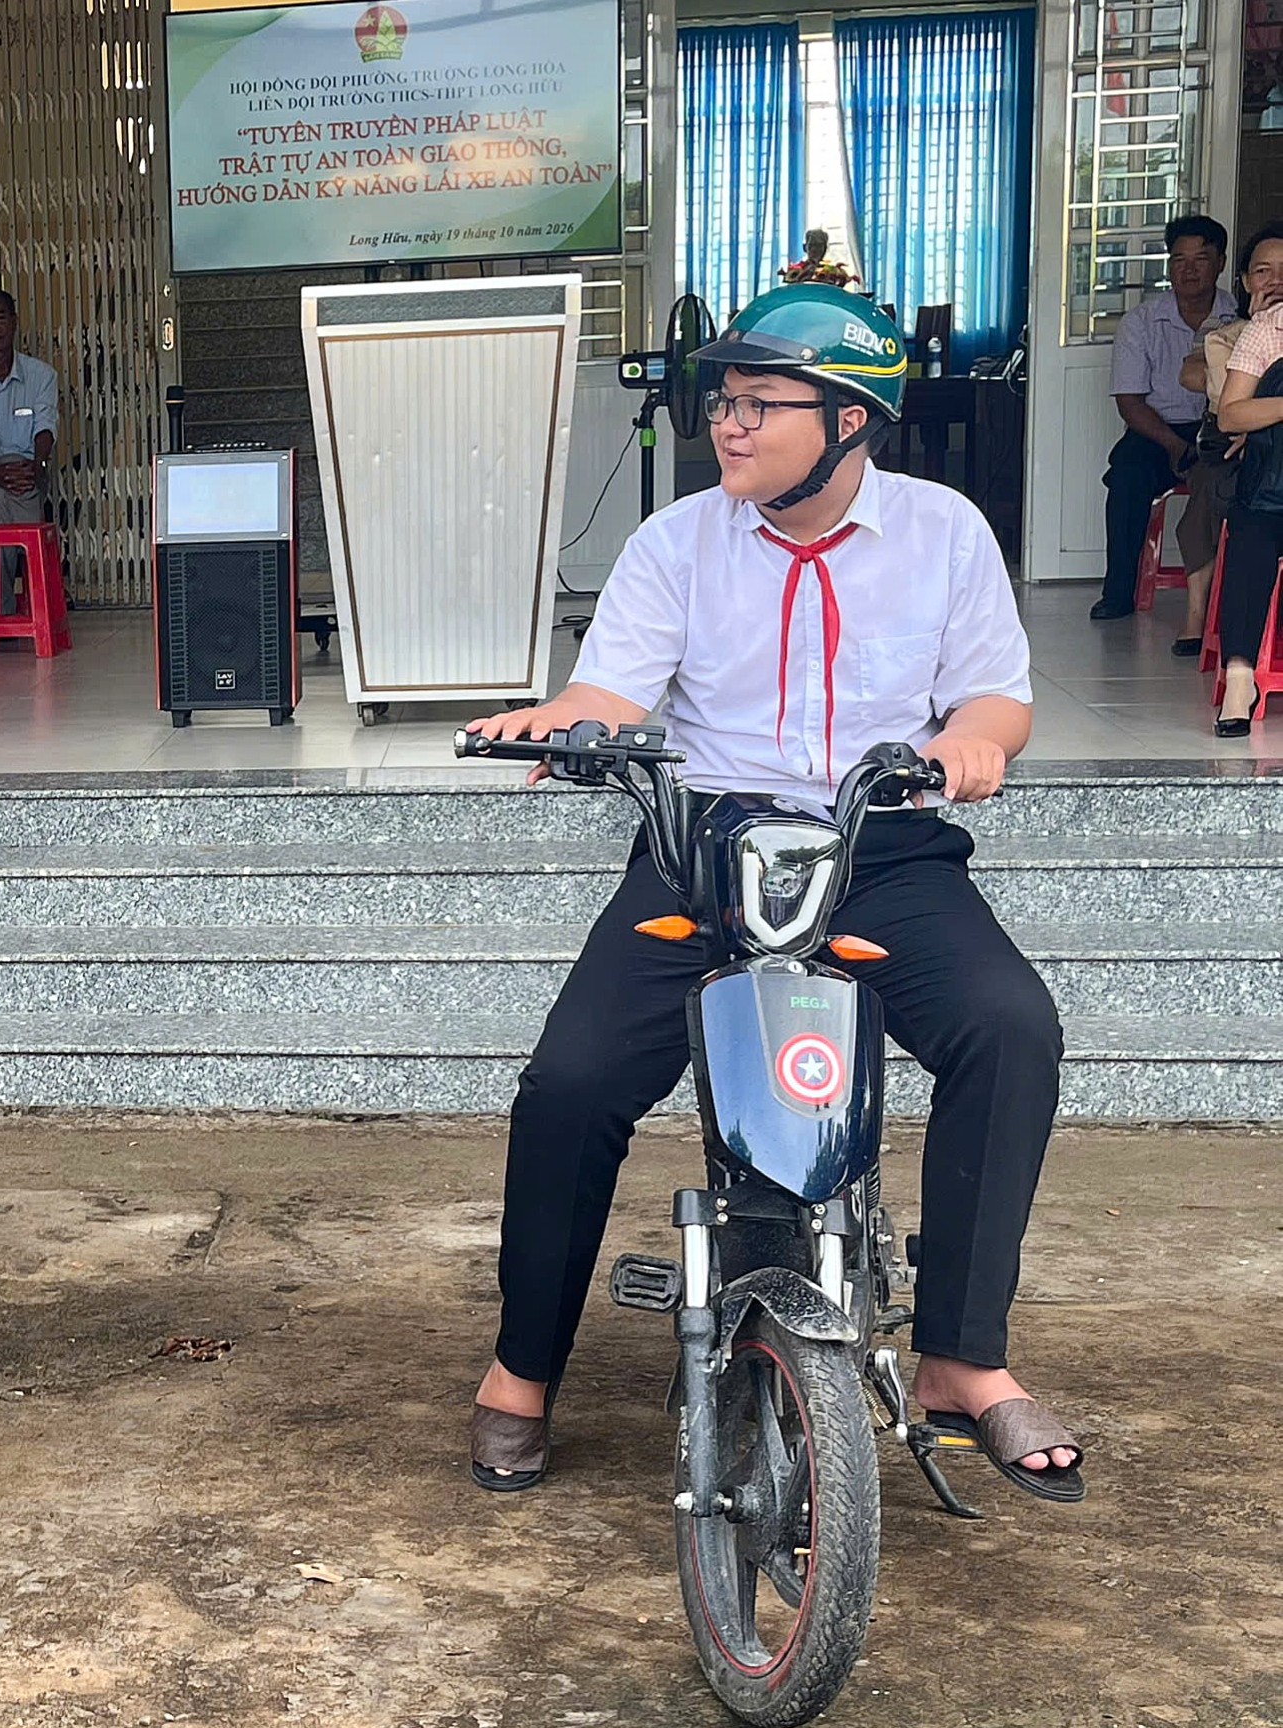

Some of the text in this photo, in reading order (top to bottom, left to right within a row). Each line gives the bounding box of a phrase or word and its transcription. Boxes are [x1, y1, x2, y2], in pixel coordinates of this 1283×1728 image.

[484, 63, 527, 78] LONG
[249, 96, 283, 111] LIÊN
[480, 83, 523, 98] LONG
[327, 113, 417, 141] TRUYỀN
[423, 110, 480, 135] PHÁP
[486, 106, 547, 131] LUẬT
[219, 135, 567, 177] TRẬT TỰ AN TOÀN GIAO THÔNG,
[177, 182, 257, 207] HƯỚNG
[263, 178, 311, 202] DẪN
[317, 175, 348, 199] KỸ
[353, 173, 418, 196] NĂNG
[423, 168, 461, 193] LÁI
[466, 171, 496, 190] XE
[501, 168, 533, 188] AN
[349, 234, 379, 247] Long
[415, 229, 443, 245] ngày
[447, 228, 460, 241] 19
[463, 227, 496, 242] tháng
[499, 225, 514, 238] 10
[517, 225, 542, 238] năm
[546, 222, 575, 236] 2026
[843, 322, 886, 353] BIDV
[790, 996, 830, 1010] PEGA
